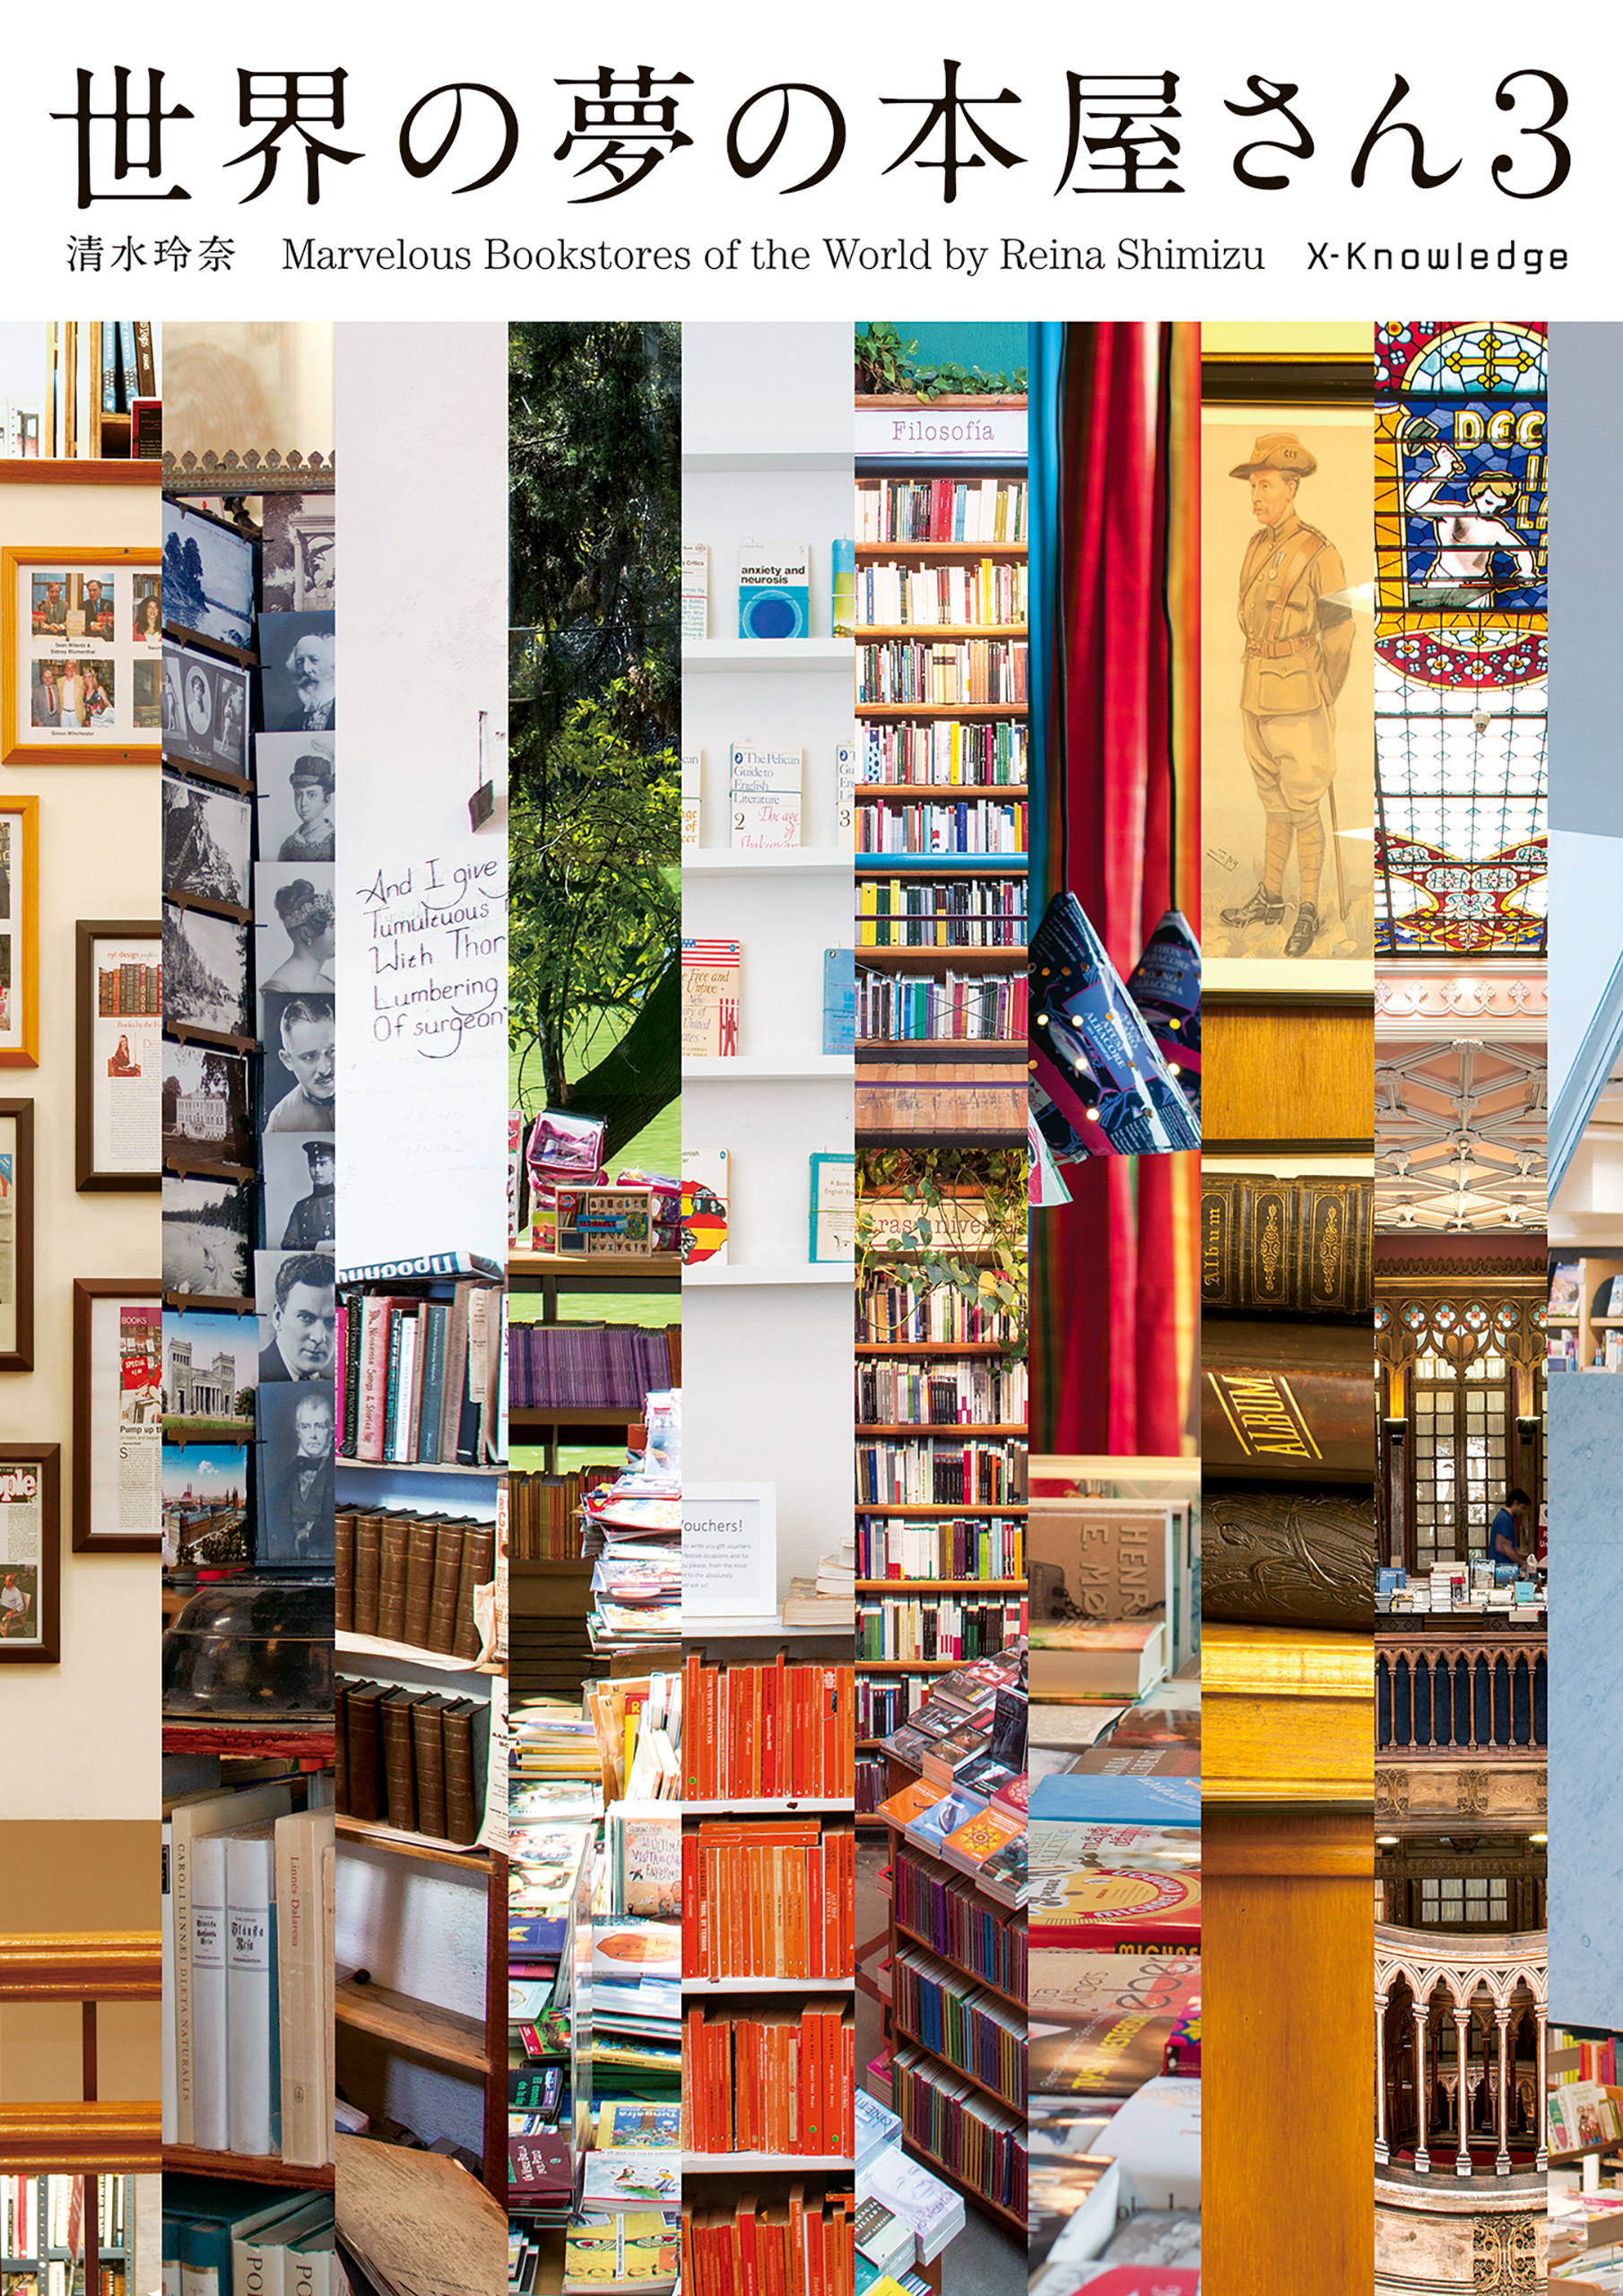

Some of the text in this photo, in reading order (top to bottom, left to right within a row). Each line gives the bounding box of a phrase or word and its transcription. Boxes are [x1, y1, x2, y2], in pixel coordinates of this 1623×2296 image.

[49, 59, 1570, 209] 世界の夢の本屋さん3
[67, 235, 235, 272] 清水玲奈
[283, 239, 1264, 276] Marvelous Bookstores of the World by Reina Shimizu
[1308, 240, 1567, 274] X-Knowledge
[892, 419, 994, 441] Filosofía
[741, 565, 805, 577] anxiety and
[741, 576, 788, 584] neurosis
[733, 766, 774, 778] Guide to
[767, 754, 800, 765] Pelican
[733, 778, 768, 791] English
[733, 792, 779, 804] Literature
[734, 812, 745, 831] 2
[839, 809, 851, 827] 3
[356, 857, 498, 909] And I give
[363, 903, 490, 939] Tumultuous
[369, 939, 433, 974] With
[374, 978, 499, 1016] Lumbering
[373, 1013, 408, 1041] Of
[1203, 1207, 1220, 1286] Album
[121, 1317, 148, 1325] BOOKS
[367, 1326, 378, 1365] Nonsense
[365, 1368, 377, 1391] Songs
[120, 1426, 142, 1435] Pump
[363, 1404, 375, 1430] Stories
[1220, 1374, 1312, 1459] ALBUM
[178, 1843, 187, 1900] CAROLI
[291, 1857, 300, 1947] Linnés Dalaresa
[181, 2020, 190, 2101] NATURALIS
